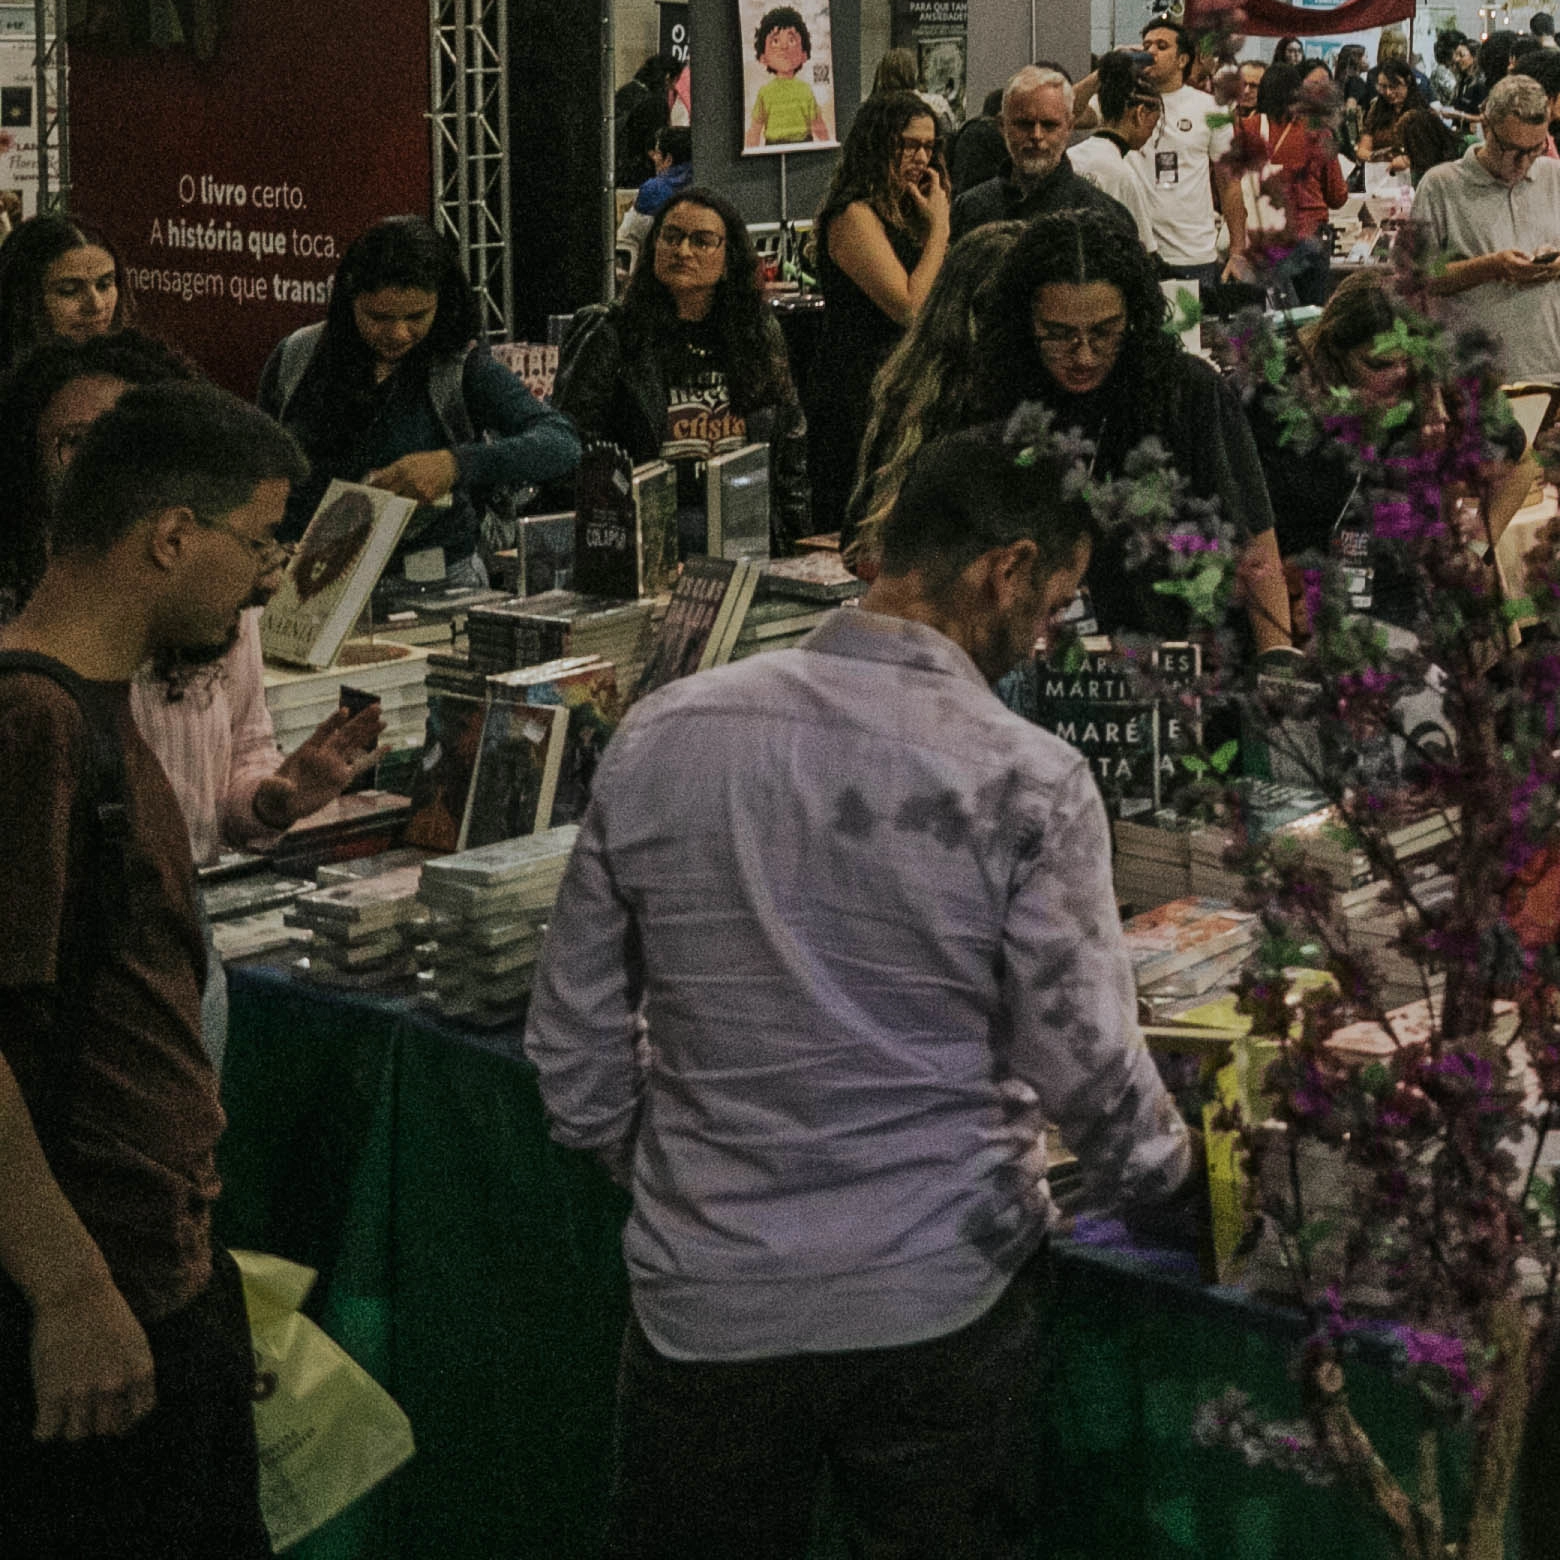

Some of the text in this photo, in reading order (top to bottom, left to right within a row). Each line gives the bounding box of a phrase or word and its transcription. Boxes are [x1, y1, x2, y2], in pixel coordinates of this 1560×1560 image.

[178, 173, 308, 211] O livro certo.
[150, 217, 341, 262] A história que toca.
[230, 273, 268, 305] que
[272, 272, 337, 304] transf
[1045, 679, 1128, 699] MARTI
[1055, 716, 1141, 744] MARÉ
[1098, 757, 1132, 782] TA
